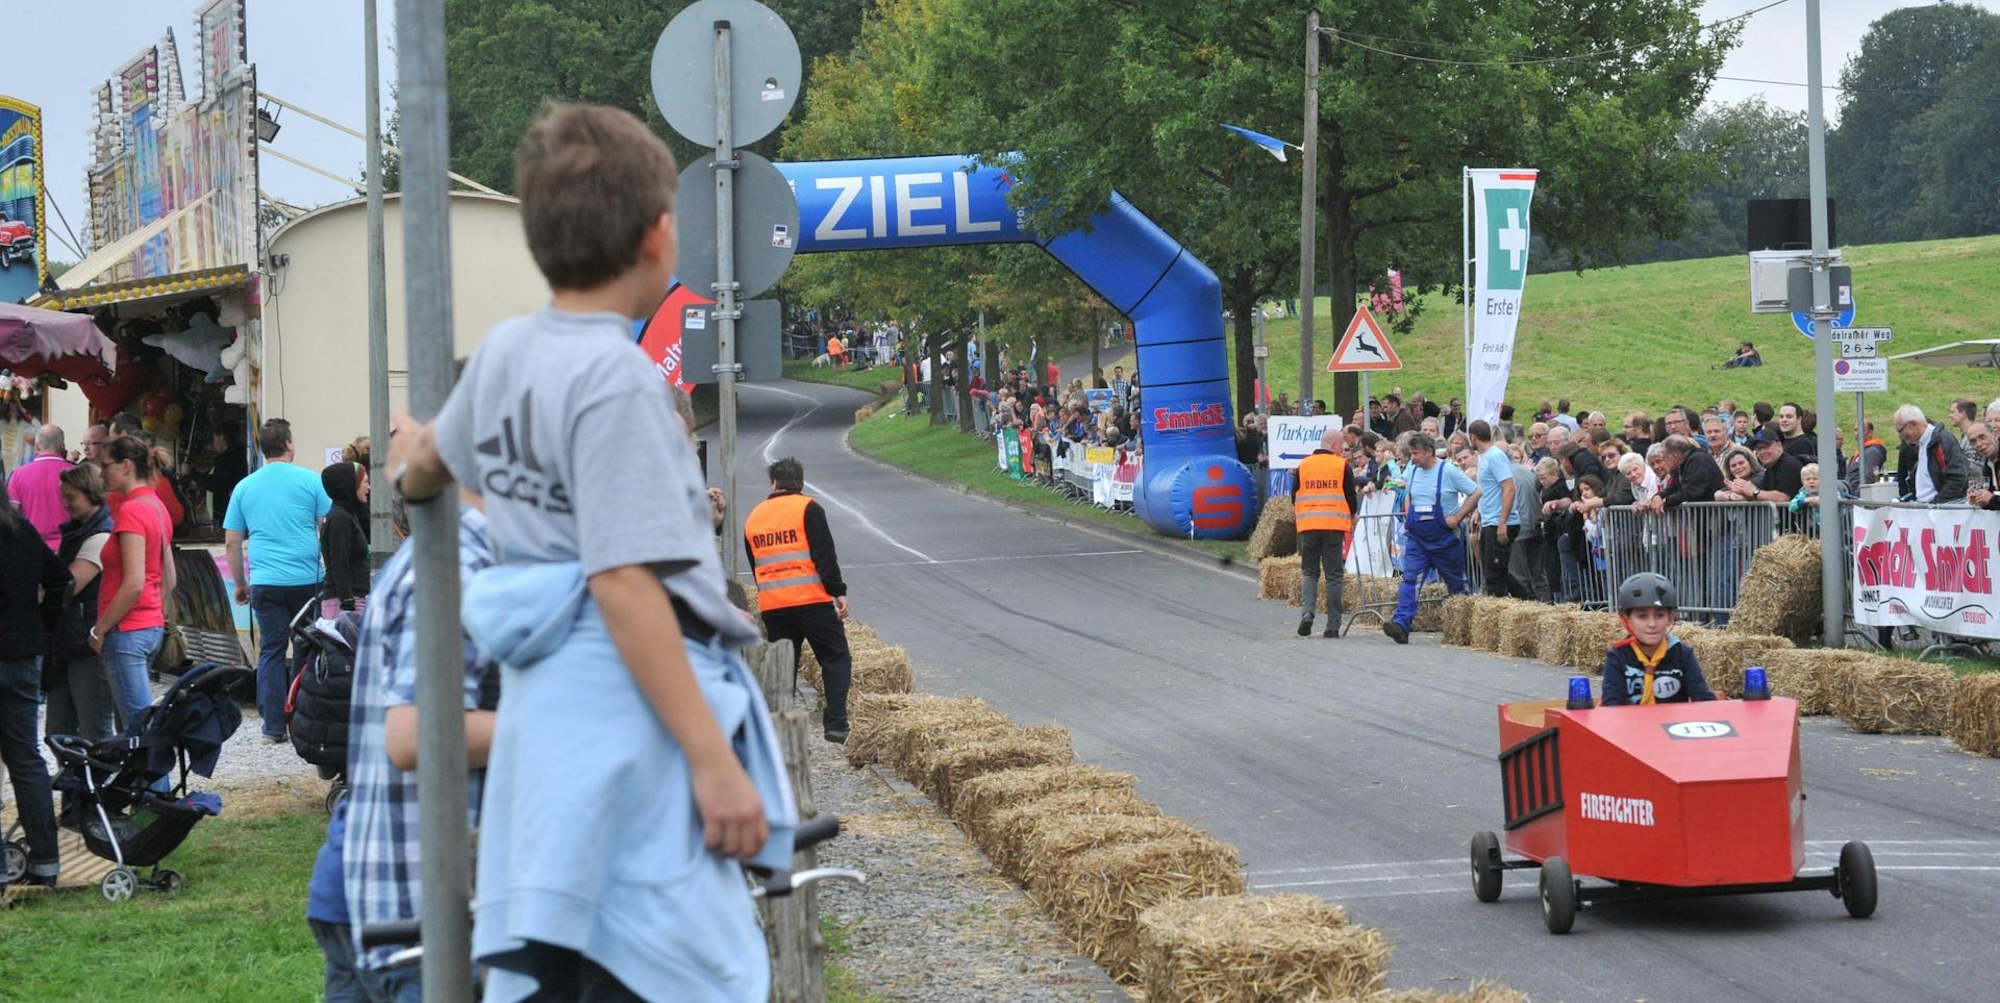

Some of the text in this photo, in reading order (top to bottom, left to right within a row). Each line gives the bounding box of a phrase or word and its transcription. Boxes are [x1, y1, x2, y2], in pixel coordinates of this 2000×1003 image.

[814, 171, 1001, 241] ZIEL
[1486, 298, 1513, 316] Erste
[1873, 330, 1890, 340] Weg
[1153, 403, 1225, 431] Smidt
[1276, 423, 1328, 444] Parkplat
[1305, 479, 1338, 490] ORDNER
[753, 529, 798, 549] ORDNER
[1920, 523, 1993, 595] Smidt
[1580, 791, 1655, 827] FIREFIGHTER
